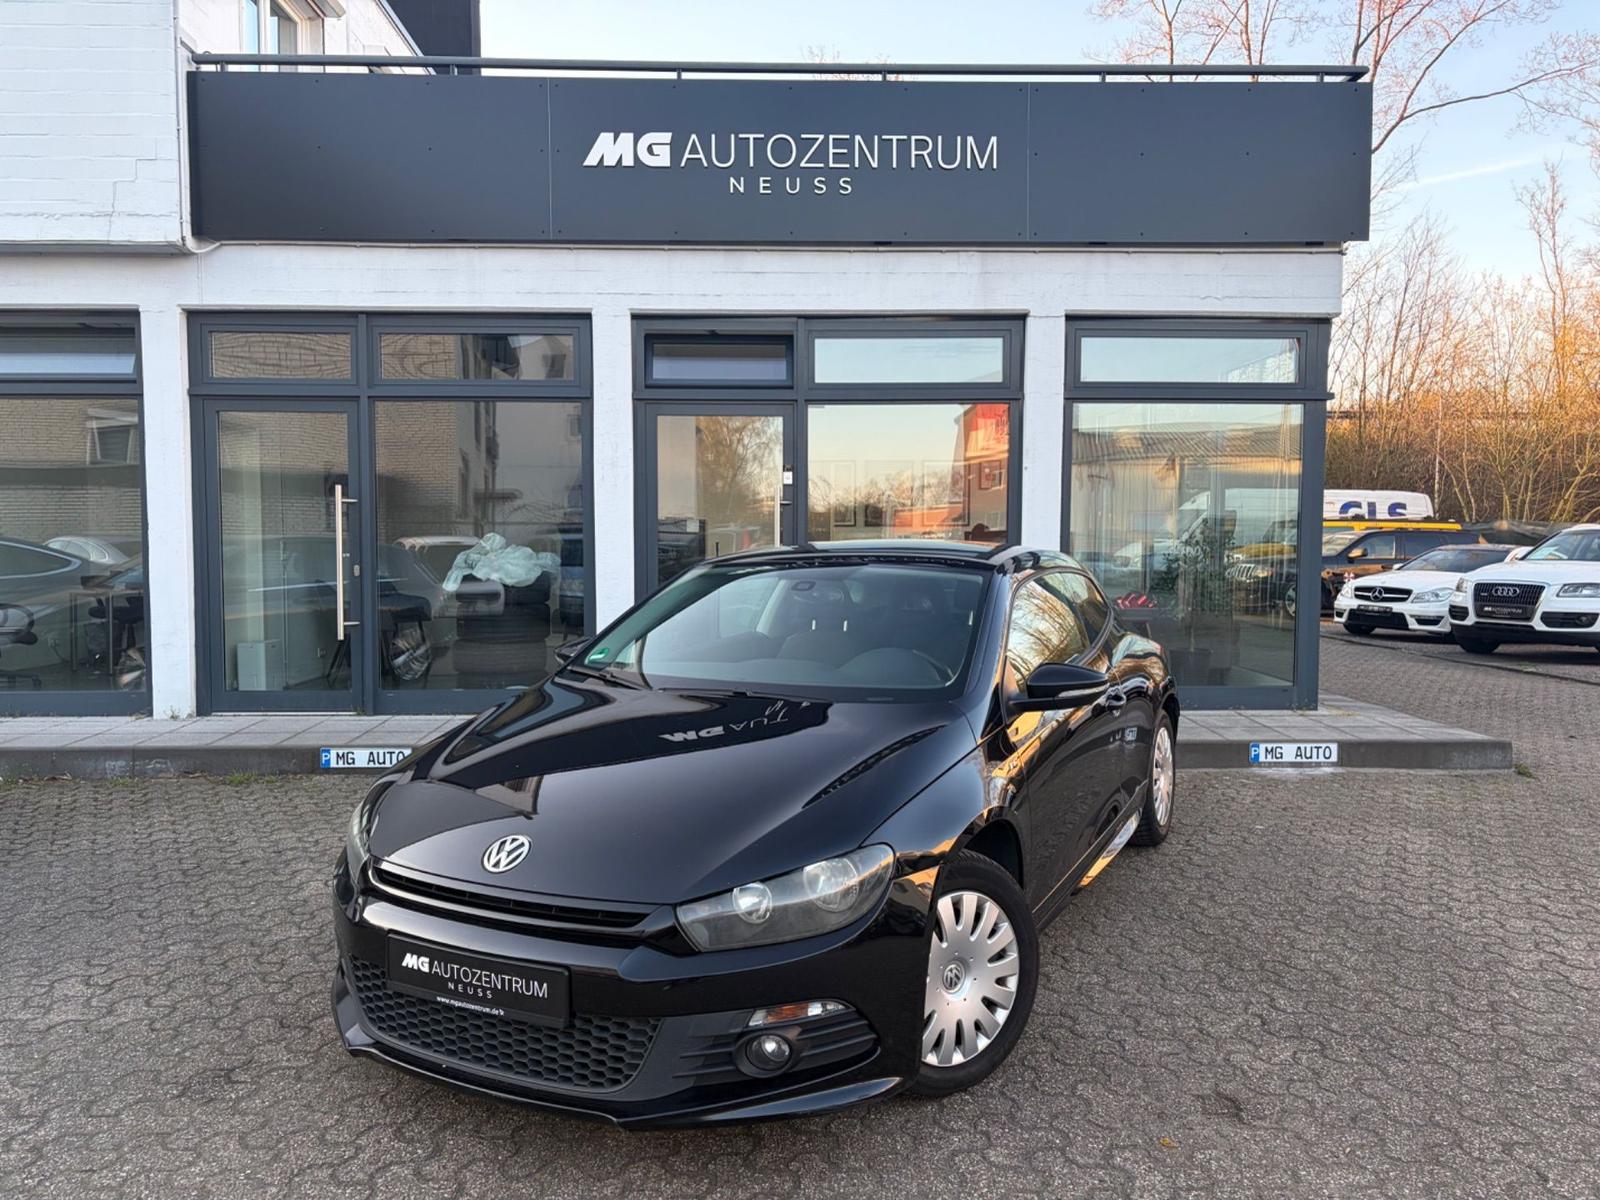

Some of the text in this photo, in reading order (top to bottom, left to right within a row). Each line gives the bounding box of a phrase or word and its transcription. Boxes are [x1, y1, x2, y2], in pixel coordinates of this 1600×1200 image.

[583, 132, 998, 170] MG AUTOZENTRUM
[729, 176, 852, 194] NEUSS
[336, 751, 356, 765] MG
[367, 751, 406, 766] AUTO
[1264, 746, 1284, 760] MG
[1294, 745, 1332, 760] AUTO
[401, 953, 548, 998] MG AUTOZENTRUM
[447, 981, 493, 999] NEUSS
